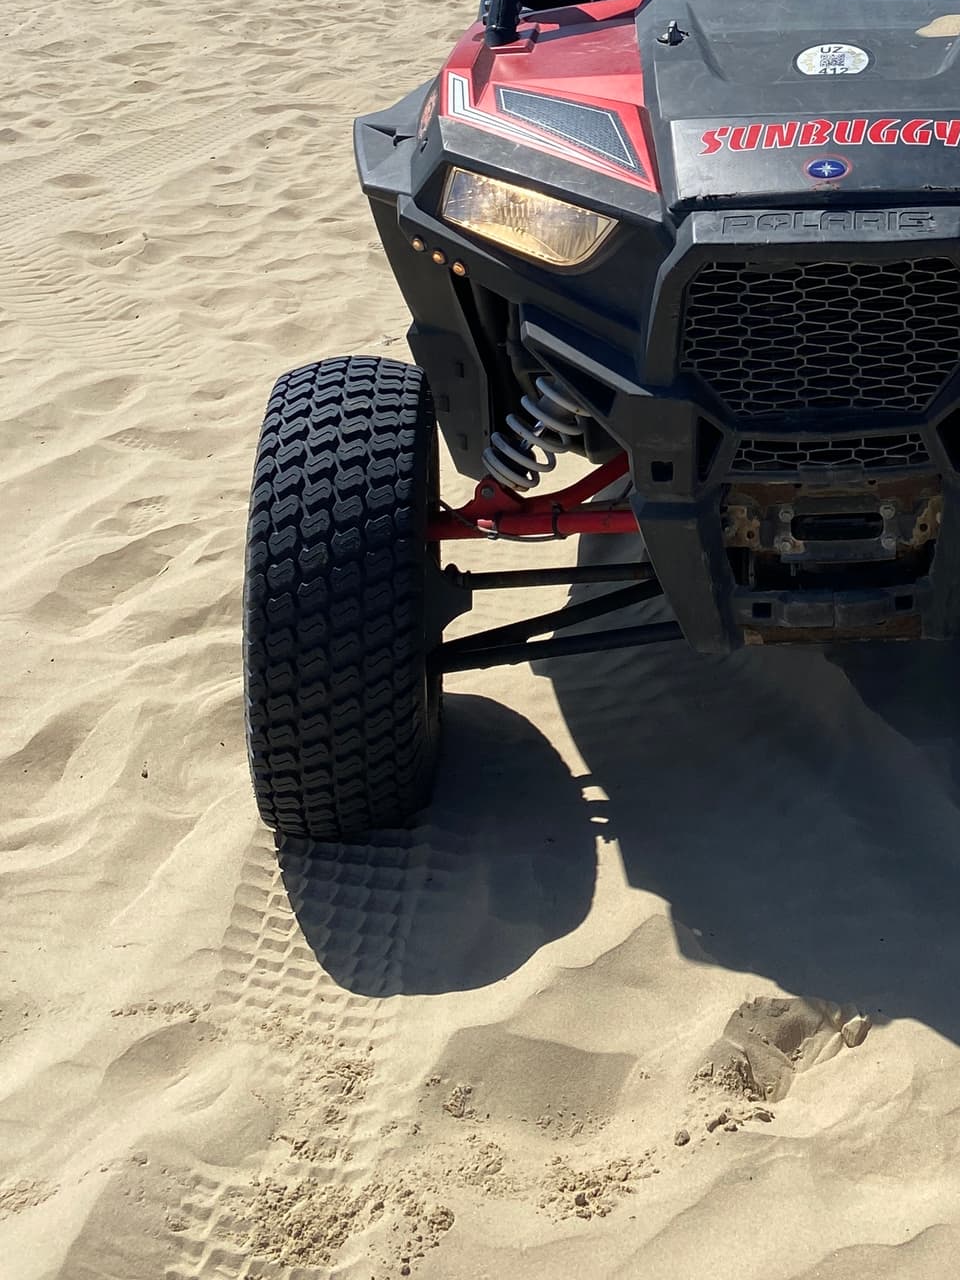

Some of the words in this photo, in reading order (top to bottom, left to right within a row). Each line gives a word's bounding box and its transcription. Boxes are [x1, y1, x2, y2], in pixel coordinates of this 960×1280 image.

[820, 46, 844, 54] UZ
[818, 67, 849, 75] 412
[721, 210, 937, 234] POLARIS
